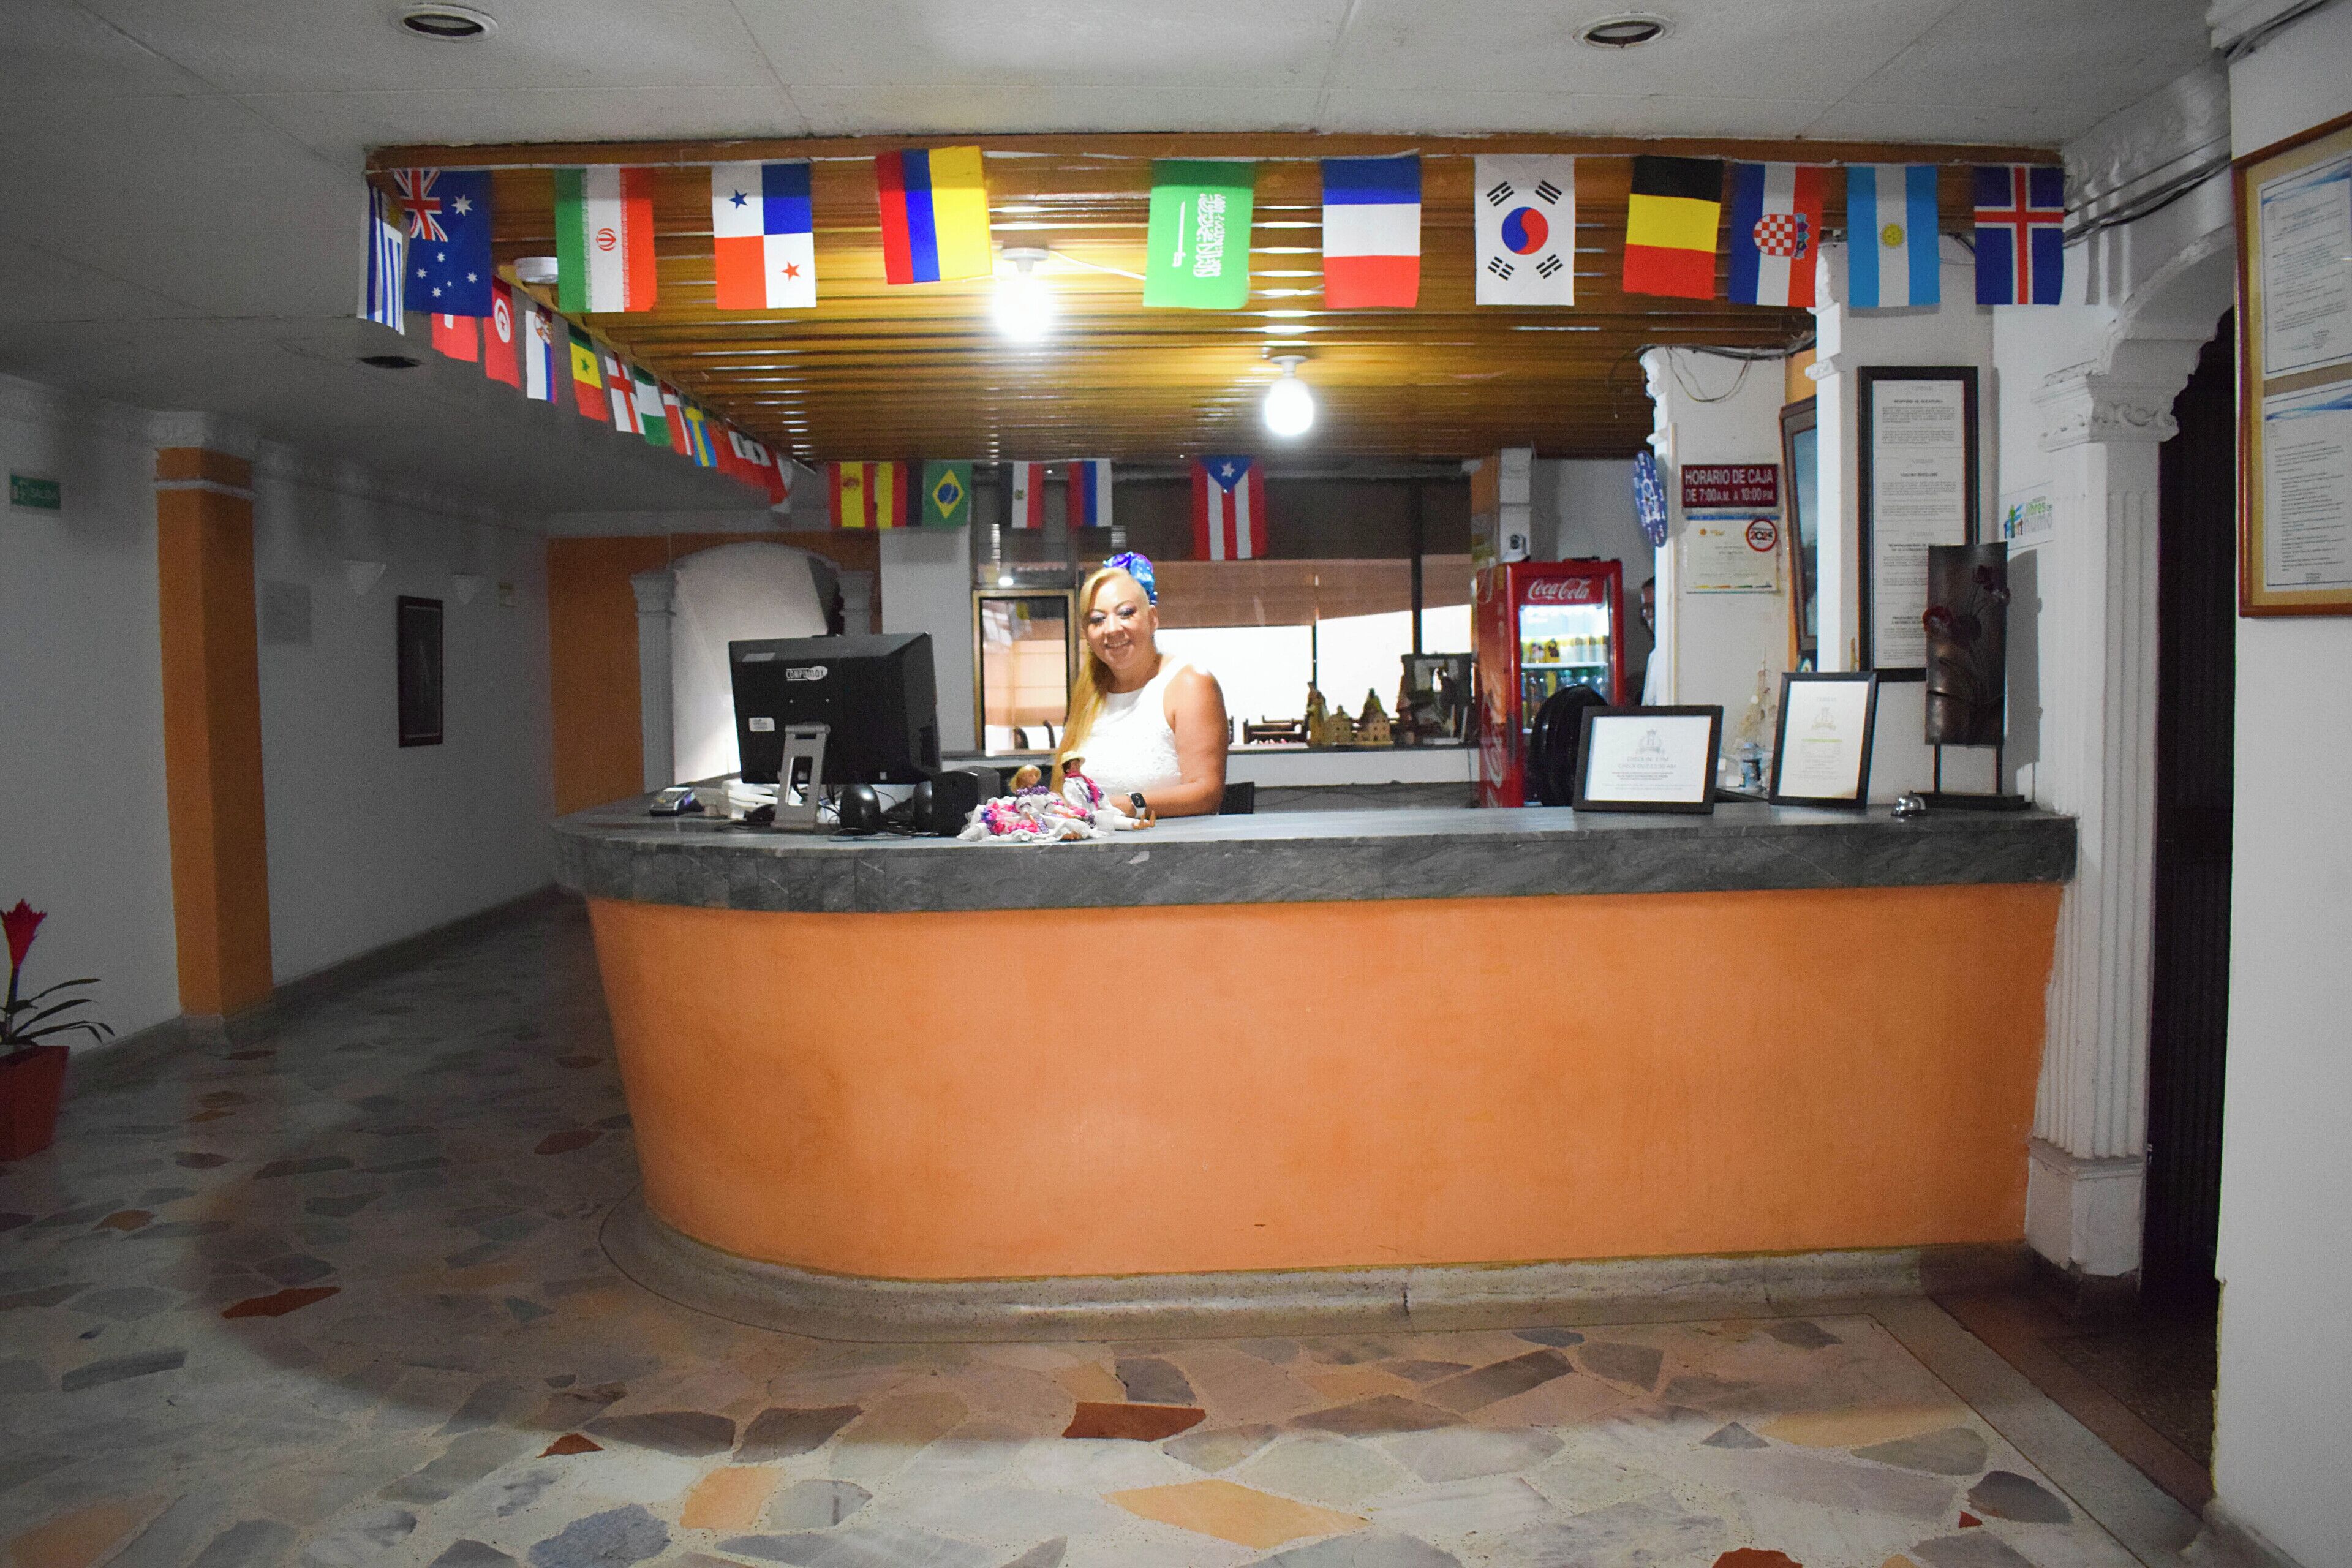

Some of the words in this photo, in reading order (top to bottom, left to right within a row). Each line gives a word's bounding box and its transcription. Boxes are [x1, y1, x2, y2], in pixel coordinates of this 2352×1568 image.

[1685, 469, 1730, 485] HORARIO
[1732, 469, 1746, 484] DE
[1747, 468, 1773, 484] CAJA
[1685, 488, 1697, 502] DE
[1733, 491, 1739, 501] A
